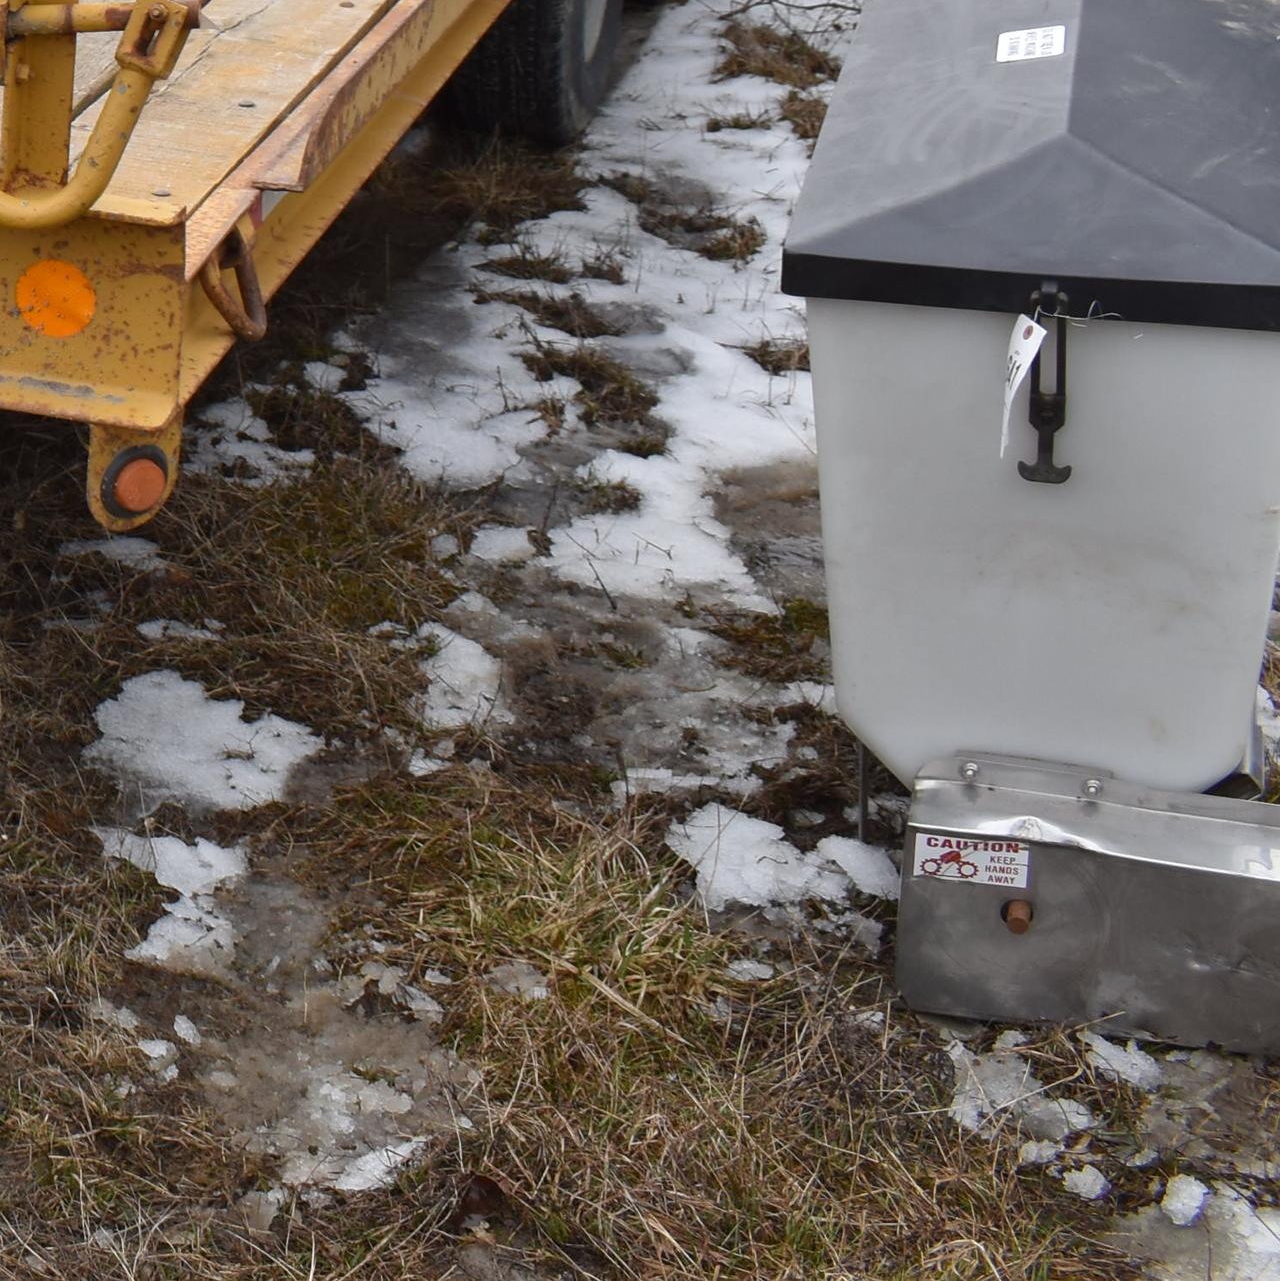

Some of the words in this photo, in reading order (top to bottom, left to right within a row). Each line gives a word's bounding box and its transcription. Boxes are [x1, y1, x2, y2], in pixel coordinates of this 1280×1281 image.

[926, 836, 1020, 854] CAUTION
[989, 855, 1016, 865] KEEP
[984, 865, 1019, 875] HANDS
[987, 874, 1015, 884] AWAY
